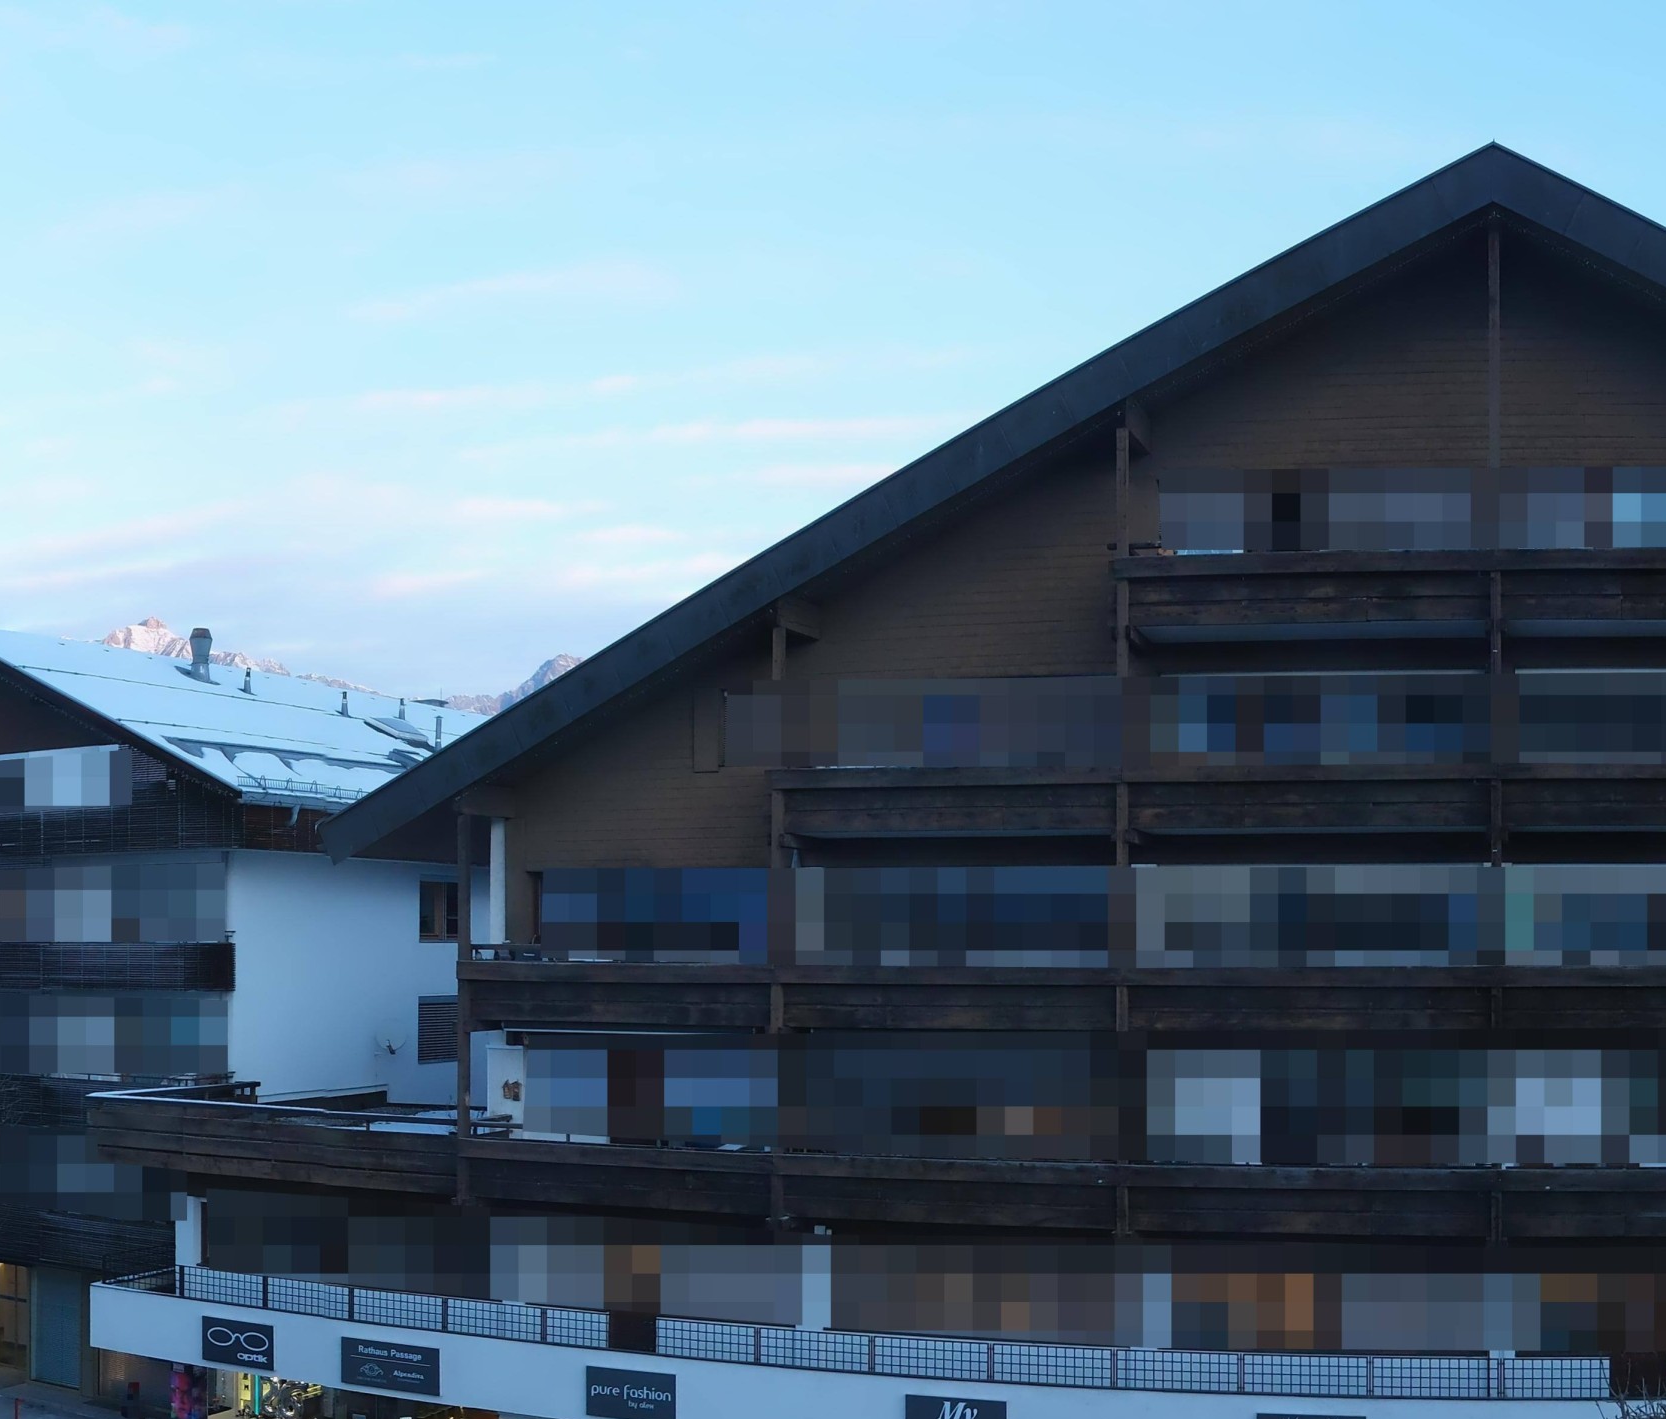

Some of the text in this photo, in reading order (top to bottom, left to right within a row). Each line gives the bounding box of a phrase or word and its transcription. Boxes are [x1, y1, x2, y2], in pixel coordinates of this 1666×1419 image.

[236, 1352, 268, 1364] optik
[358, 1344, 422, 1362] Rathaus Passage
[591, 1384, 672, 1403] pure fashion
[628, 1400, 637, 1409] by
